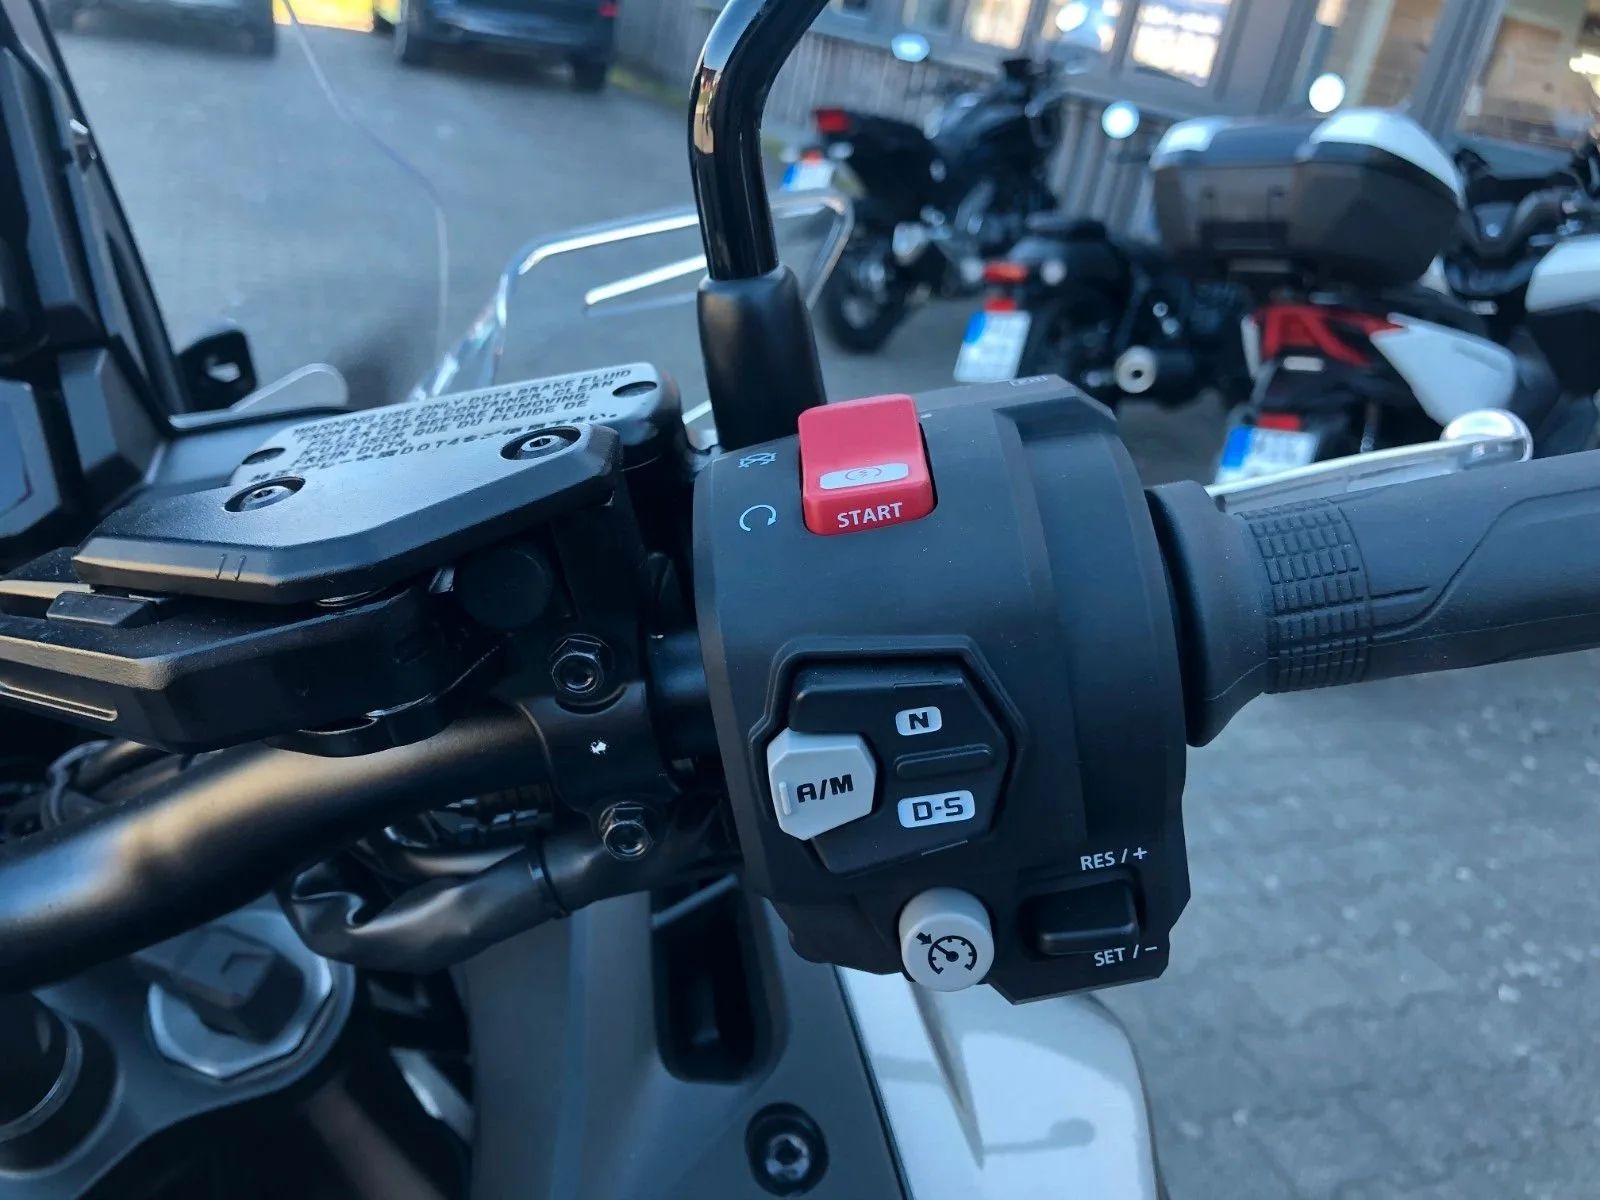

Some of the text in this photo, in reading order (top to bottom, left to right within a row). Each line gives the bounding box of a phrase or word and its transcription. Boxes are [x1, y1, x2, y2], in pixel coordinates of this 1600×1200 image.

[293, 370, 631, 436] WARNING USE ONLY DOT4 BRAKE FLUID
[297, 427, 347, 441] FROM
[366, 411, 438, 429] SEALED
[552, 380, 613, 396] CLEAN
[374, 423, 412, 435] CAP
[416, 409, 489, 428] BEFORE
[412, 423, 450, 437] QUE
[455, 418, 482, 429] DU
[487, 405, 556, 423] FLUIDE
[563, 399, 588, 410] DE
[290, 449, 350, 466] FREIN
[837, 502, 903, 528] START
[908, 712, 930, 730] N
[797, 774, 854, 803] A/M
[912, 797, 964, 822] D-S
[1080, 851, 1116, 871] RES
[1094, 948, 1126, 967] SET
